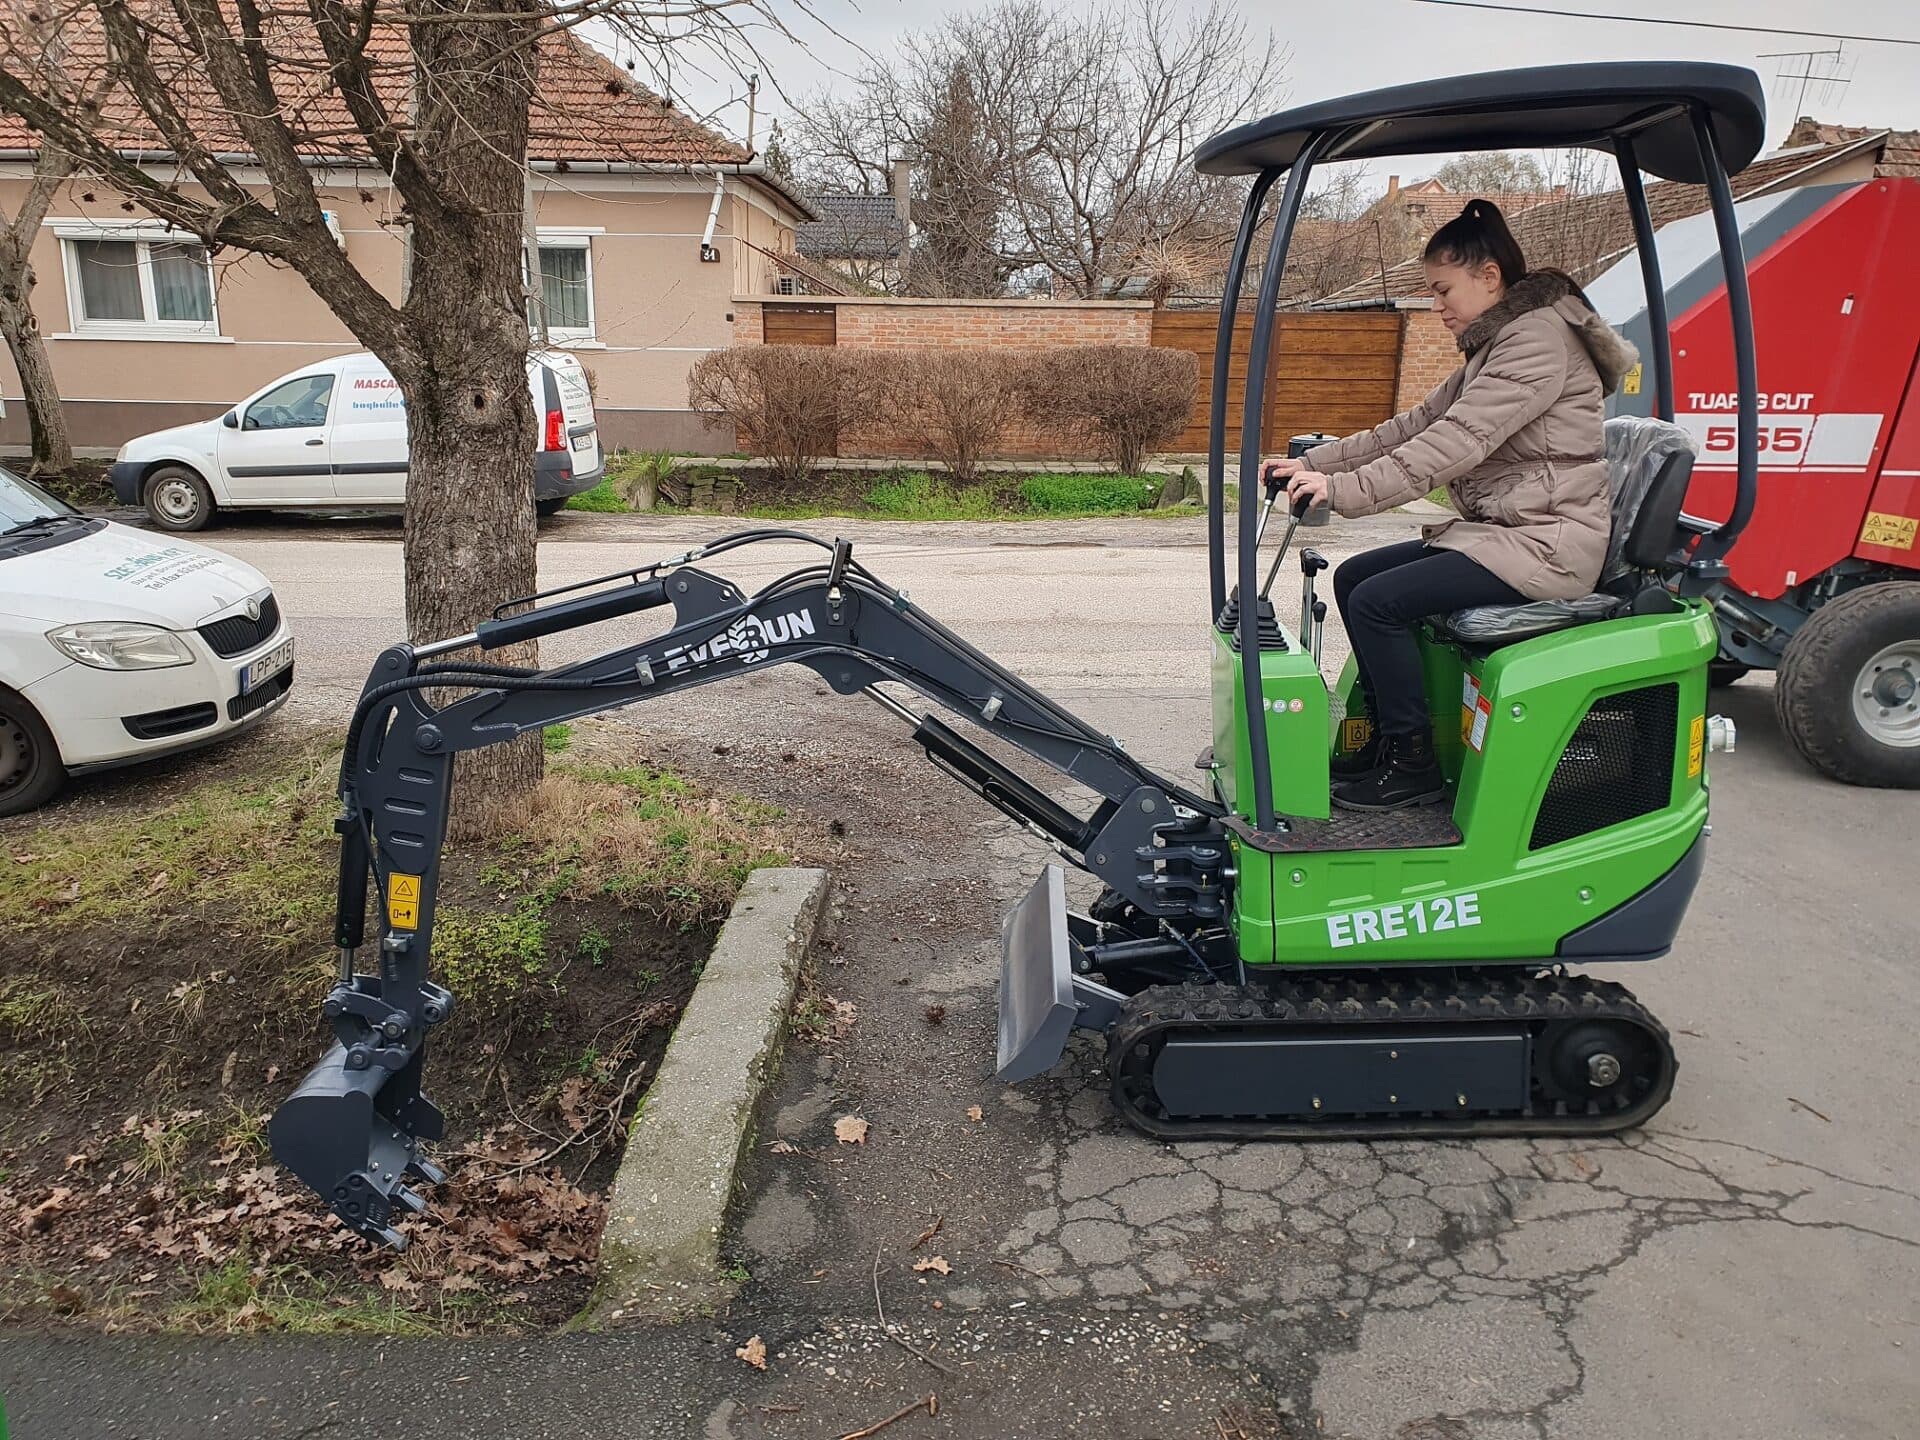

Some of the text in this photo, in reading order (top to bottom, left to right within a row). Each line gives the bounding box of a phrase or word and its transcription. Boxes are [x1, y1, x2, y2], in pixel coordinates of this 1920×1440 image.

[1772, 392, 1814, 410] CUT
[250, 642, 291, 684] LPP-215
[1326, 892, 1482, 948] ERE12E
